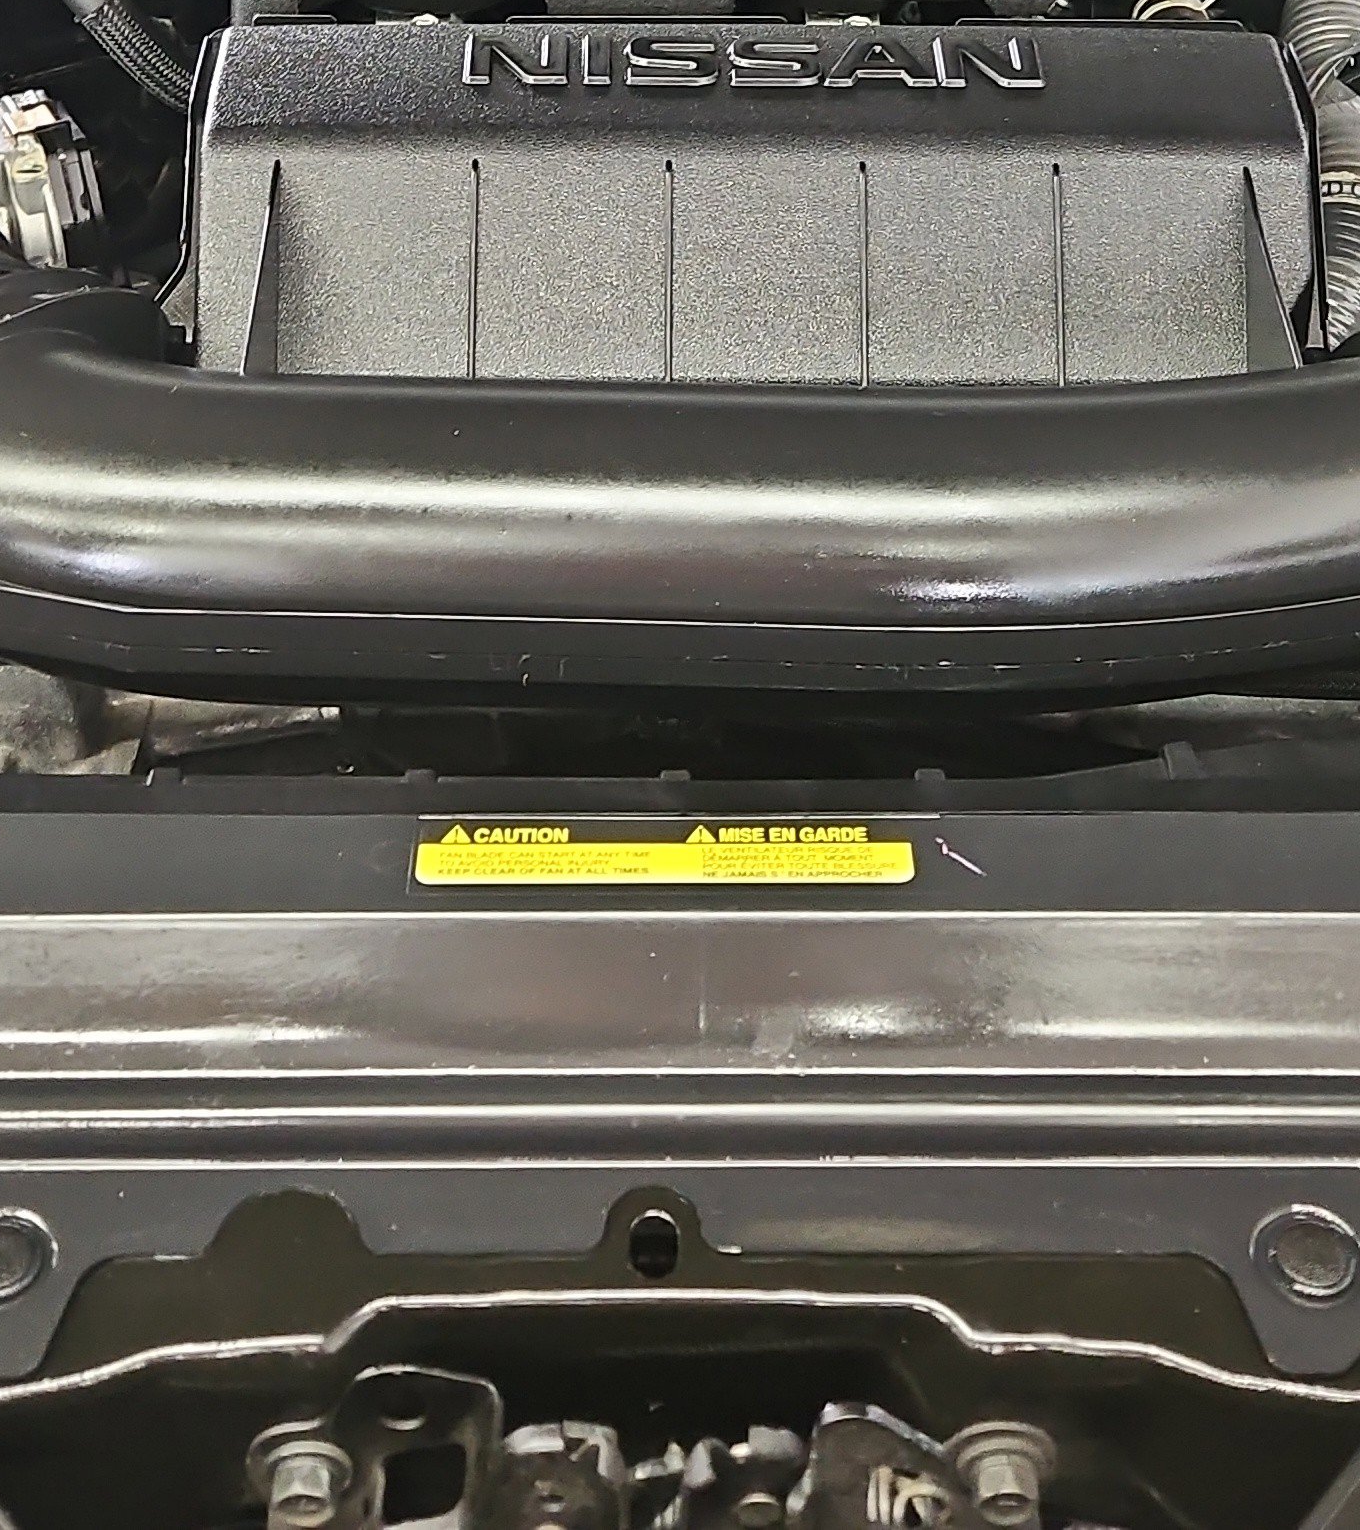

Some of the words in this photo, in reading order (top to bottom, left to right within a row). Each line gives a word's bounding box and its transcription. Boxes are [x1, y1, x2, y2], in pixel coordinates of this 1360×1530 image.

[462, 31, 1046, 89] NISSAN
[473, 827, 570, 844] CAUTION
[718, 827, 766, 843] MISE
[768, 827, 797, 843] EN
[799, 826, 869, 843] GARDE
